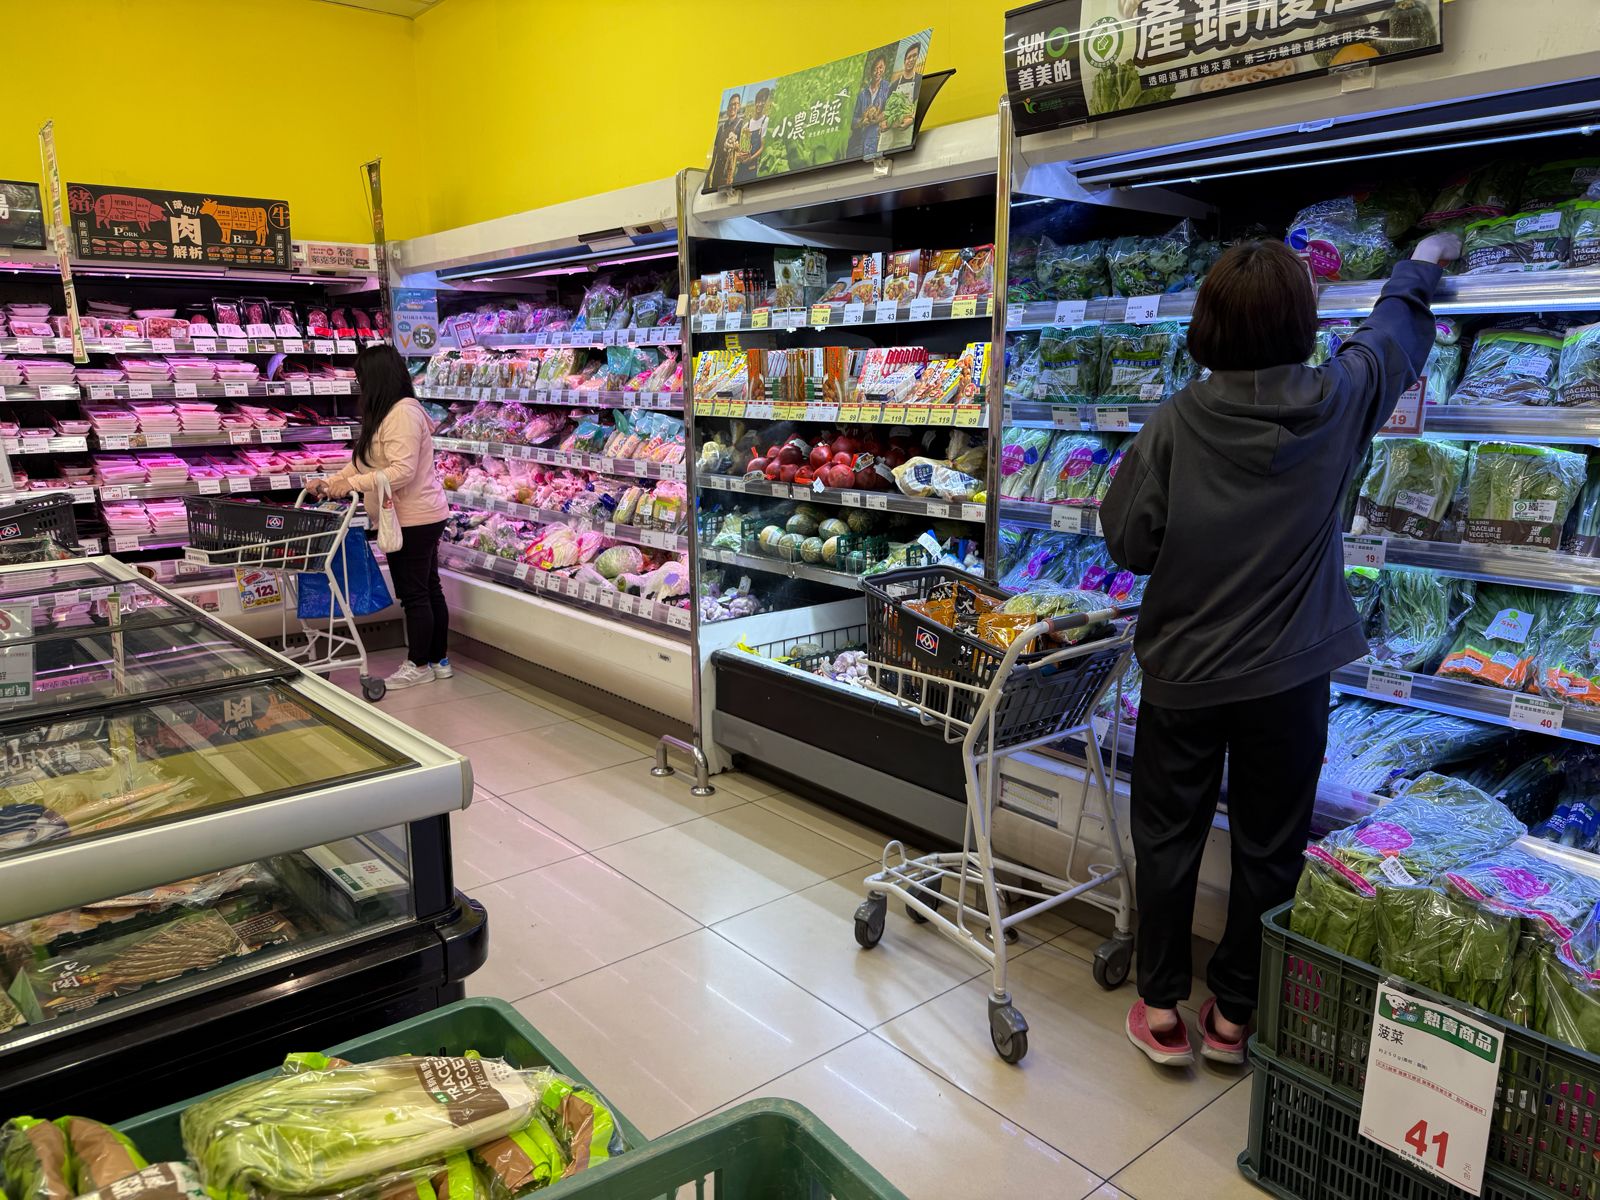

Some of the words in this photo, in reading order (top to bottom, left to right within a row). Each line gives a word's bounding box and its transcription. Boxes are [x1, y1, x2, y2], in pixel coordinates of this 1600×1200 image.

[1136, 0, 1364, 60] 產銷
[1017, 32, 1045, 56] SUN
[1017, 50, 1045, 68] MAKE
[1018, 59, 1072, 91] 善美的
[771, 100, 842, 140] 小農直採
[272, 206, 290, 227] 牛
[170, 214, 203, 246] 肉
[173, 246, 203, 260] 解析
[1144, 310, 1154, 319] 36
[1391, 414, 1407, 425] 19
[1365, 554, 1376, 563] 19
[1392, 689, 1404, 698] 40
[1540, 718, 1553, 729] 40
[1377, 1023, 1405, 1046] 菠菜
[1422, 1010, 1492, 1053] 熱賣商品
[434, 1057, 463, 1100] TRACE
[452, 1057, 476, 1095] VEGE
[1404, 1119, 1449, 1169] 41
